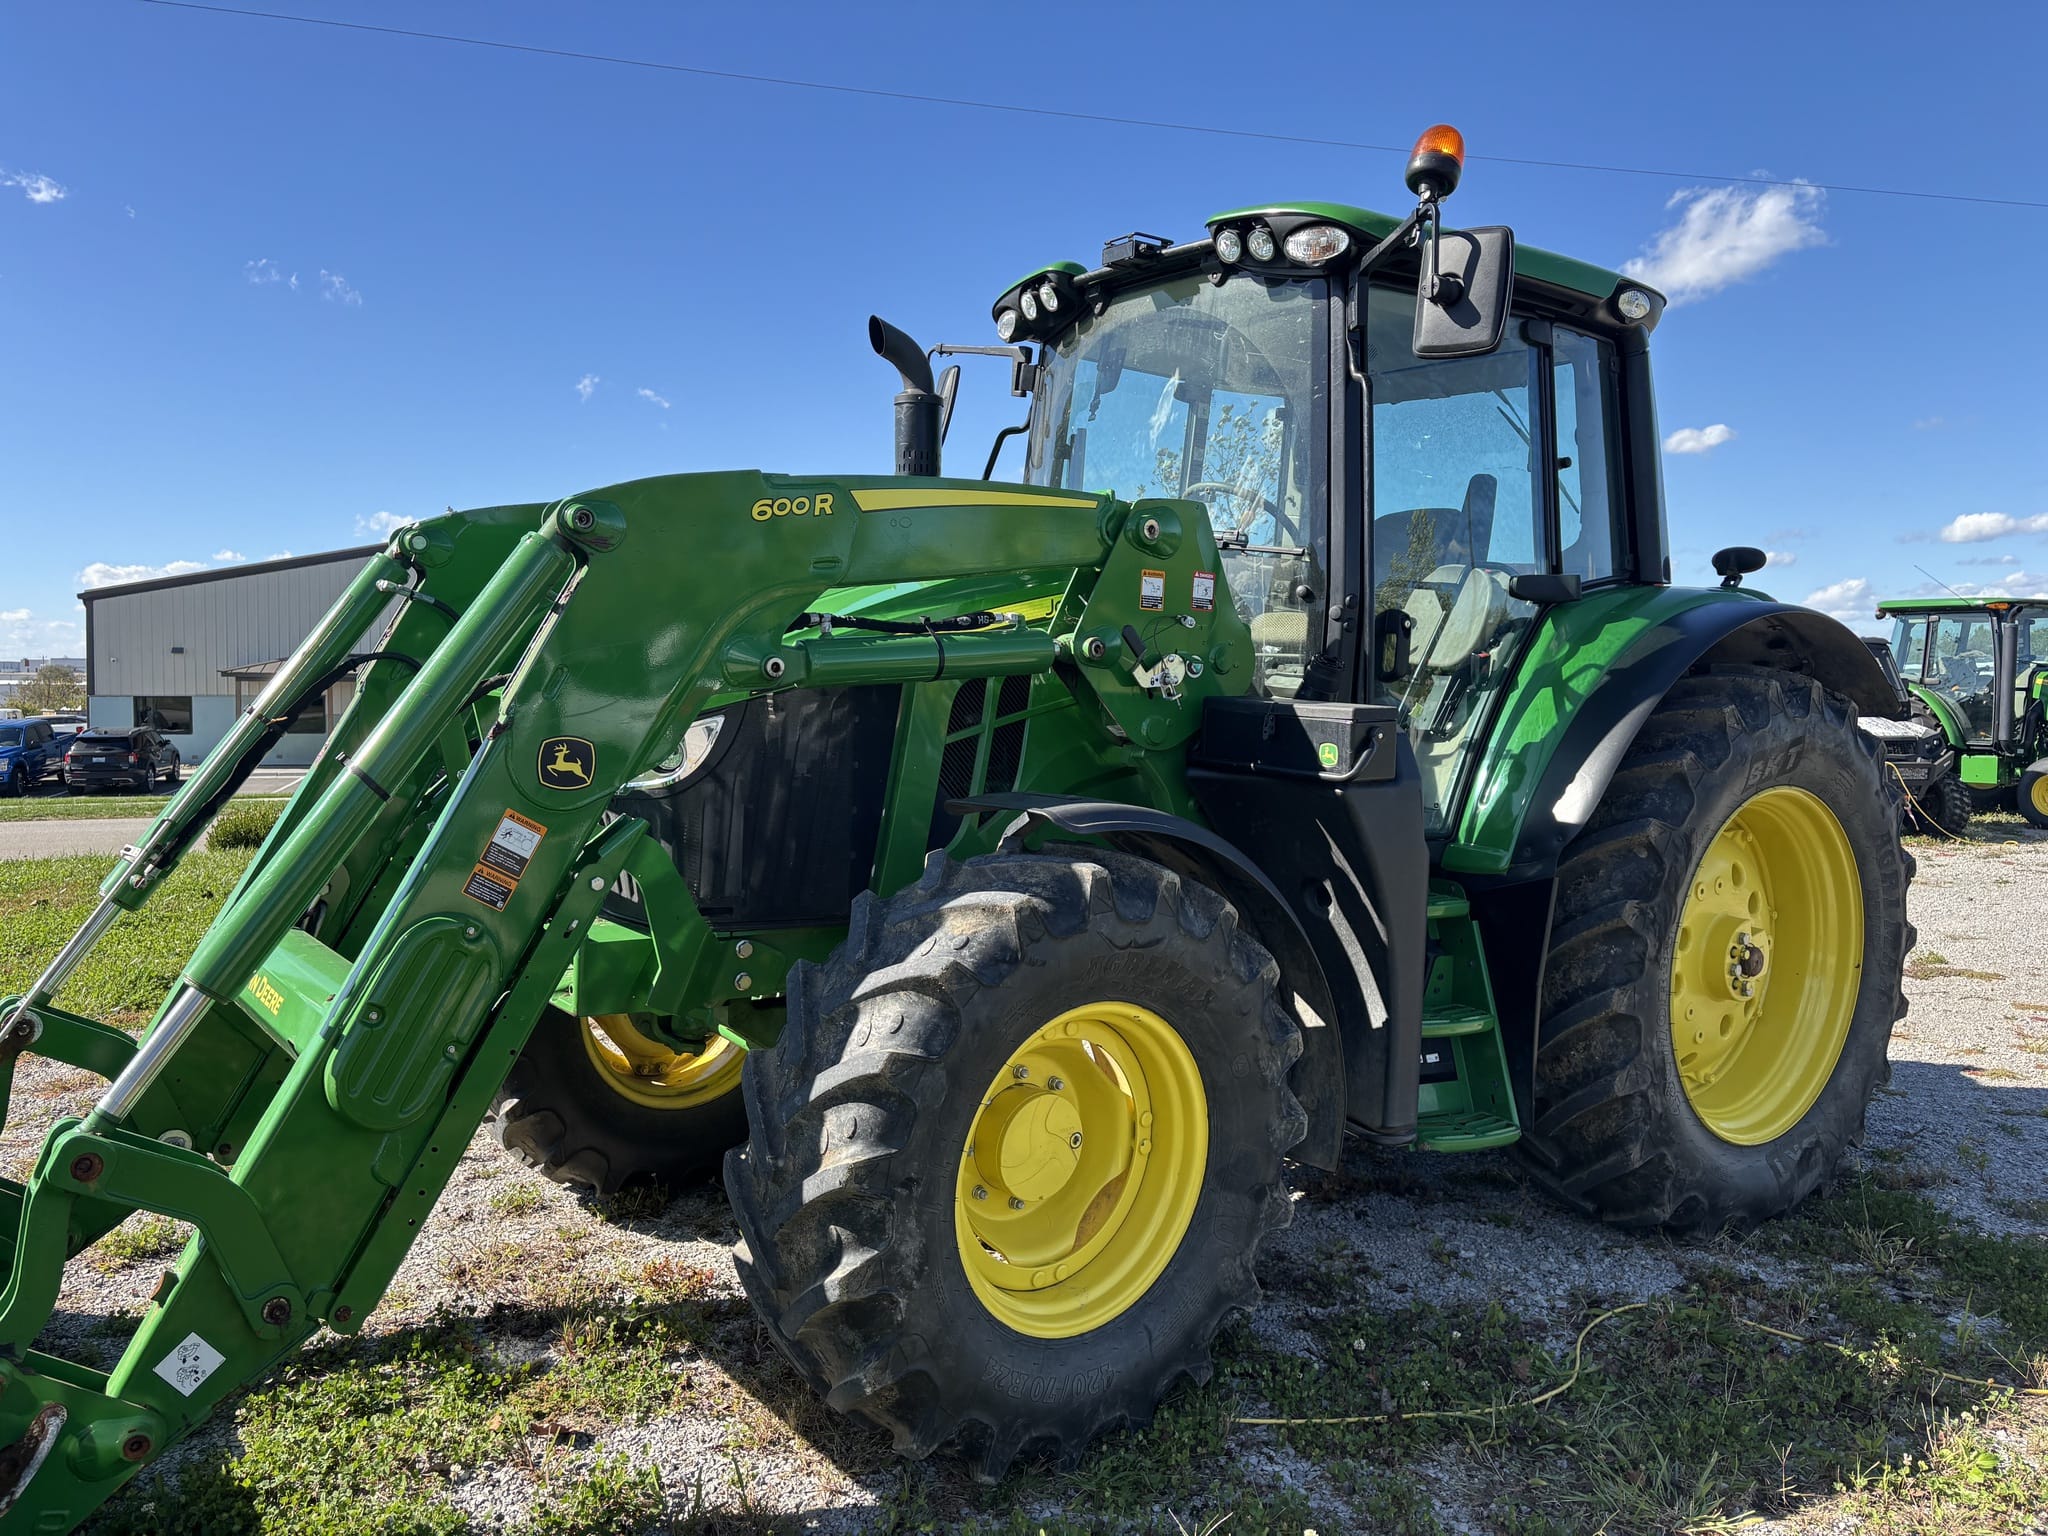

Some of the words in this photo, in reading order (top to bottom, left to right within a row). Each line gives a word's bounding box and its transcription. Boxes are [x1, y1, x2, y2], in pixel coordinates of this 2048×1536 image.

[515, 814, 543, 833] WARNING
[486, 869, 514, 888] WARNING
[255, 976, 286, 1016] DEERE
